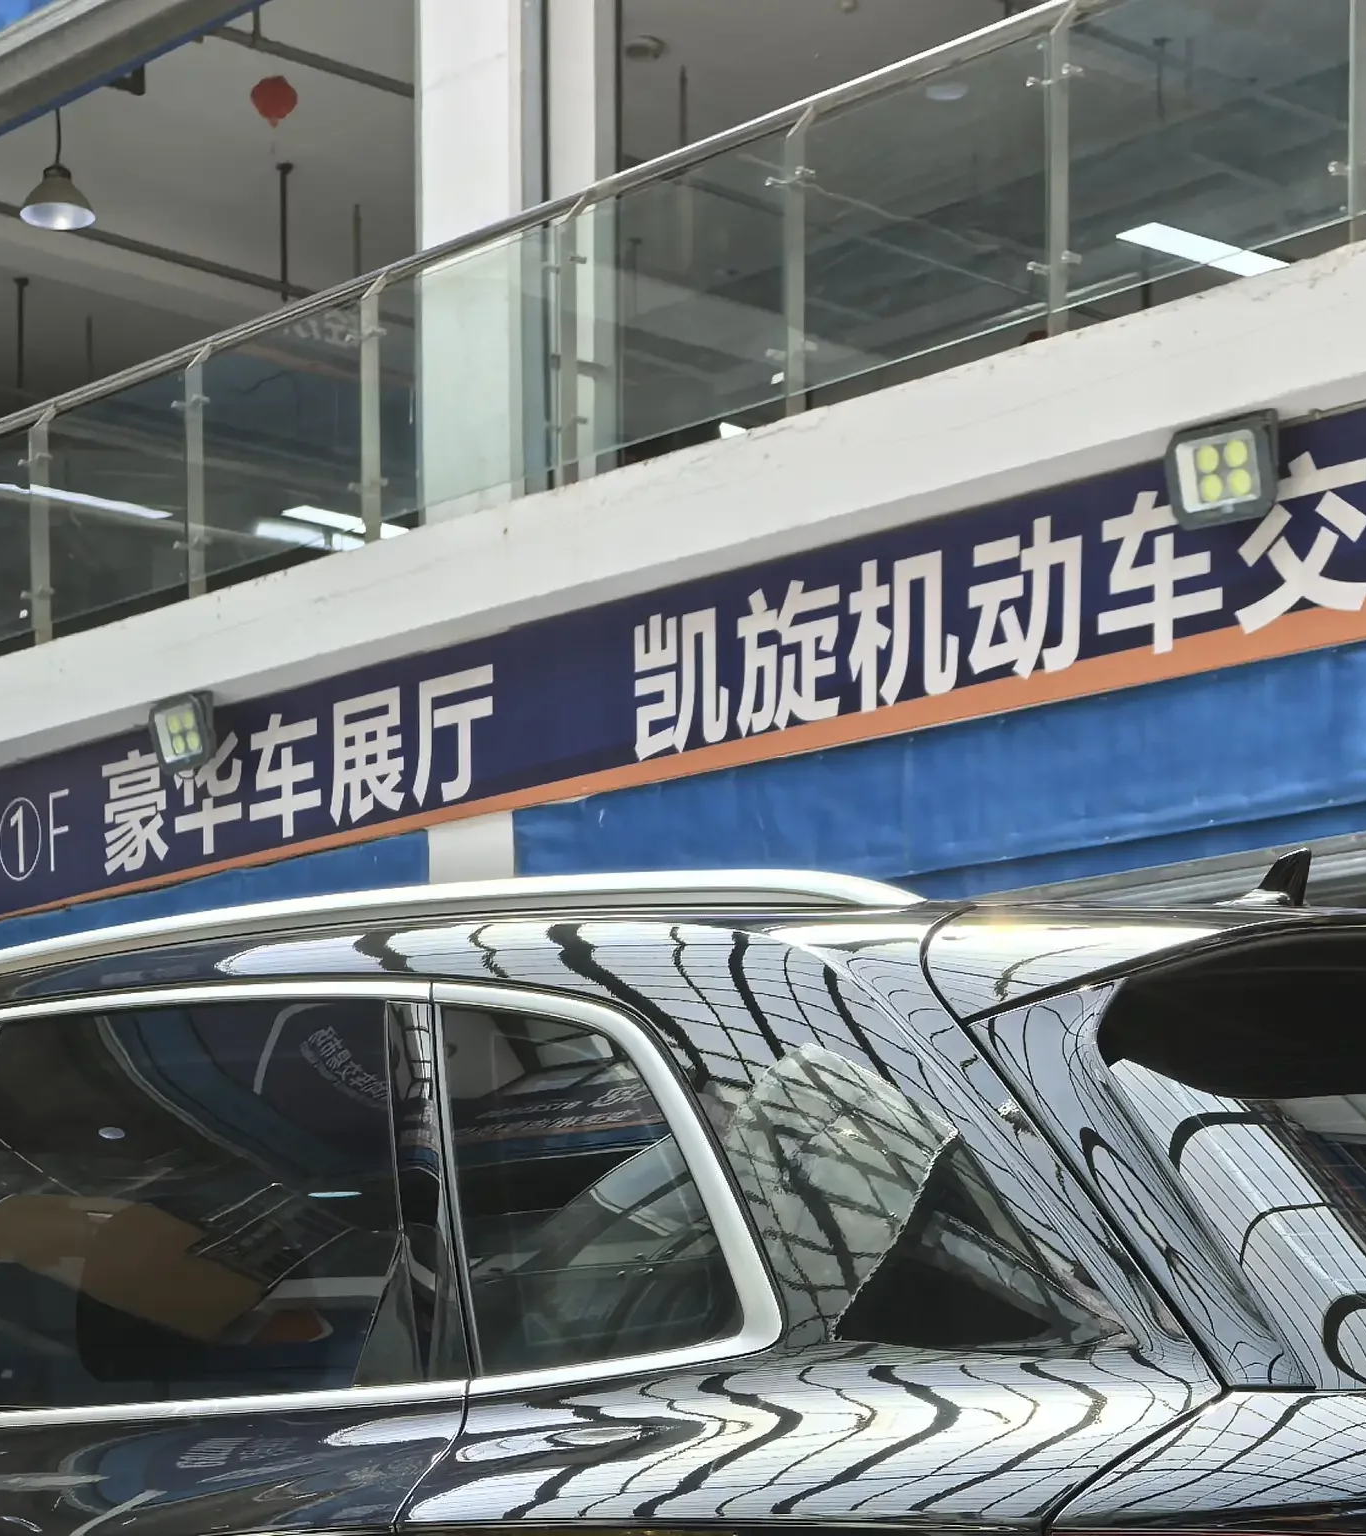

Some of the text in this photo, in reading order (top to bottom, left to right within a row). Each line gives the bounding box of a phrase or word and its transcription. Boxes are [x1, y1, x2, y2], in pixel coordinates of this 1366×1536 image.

[101, 664, 494, 876] 豪华车展厅
